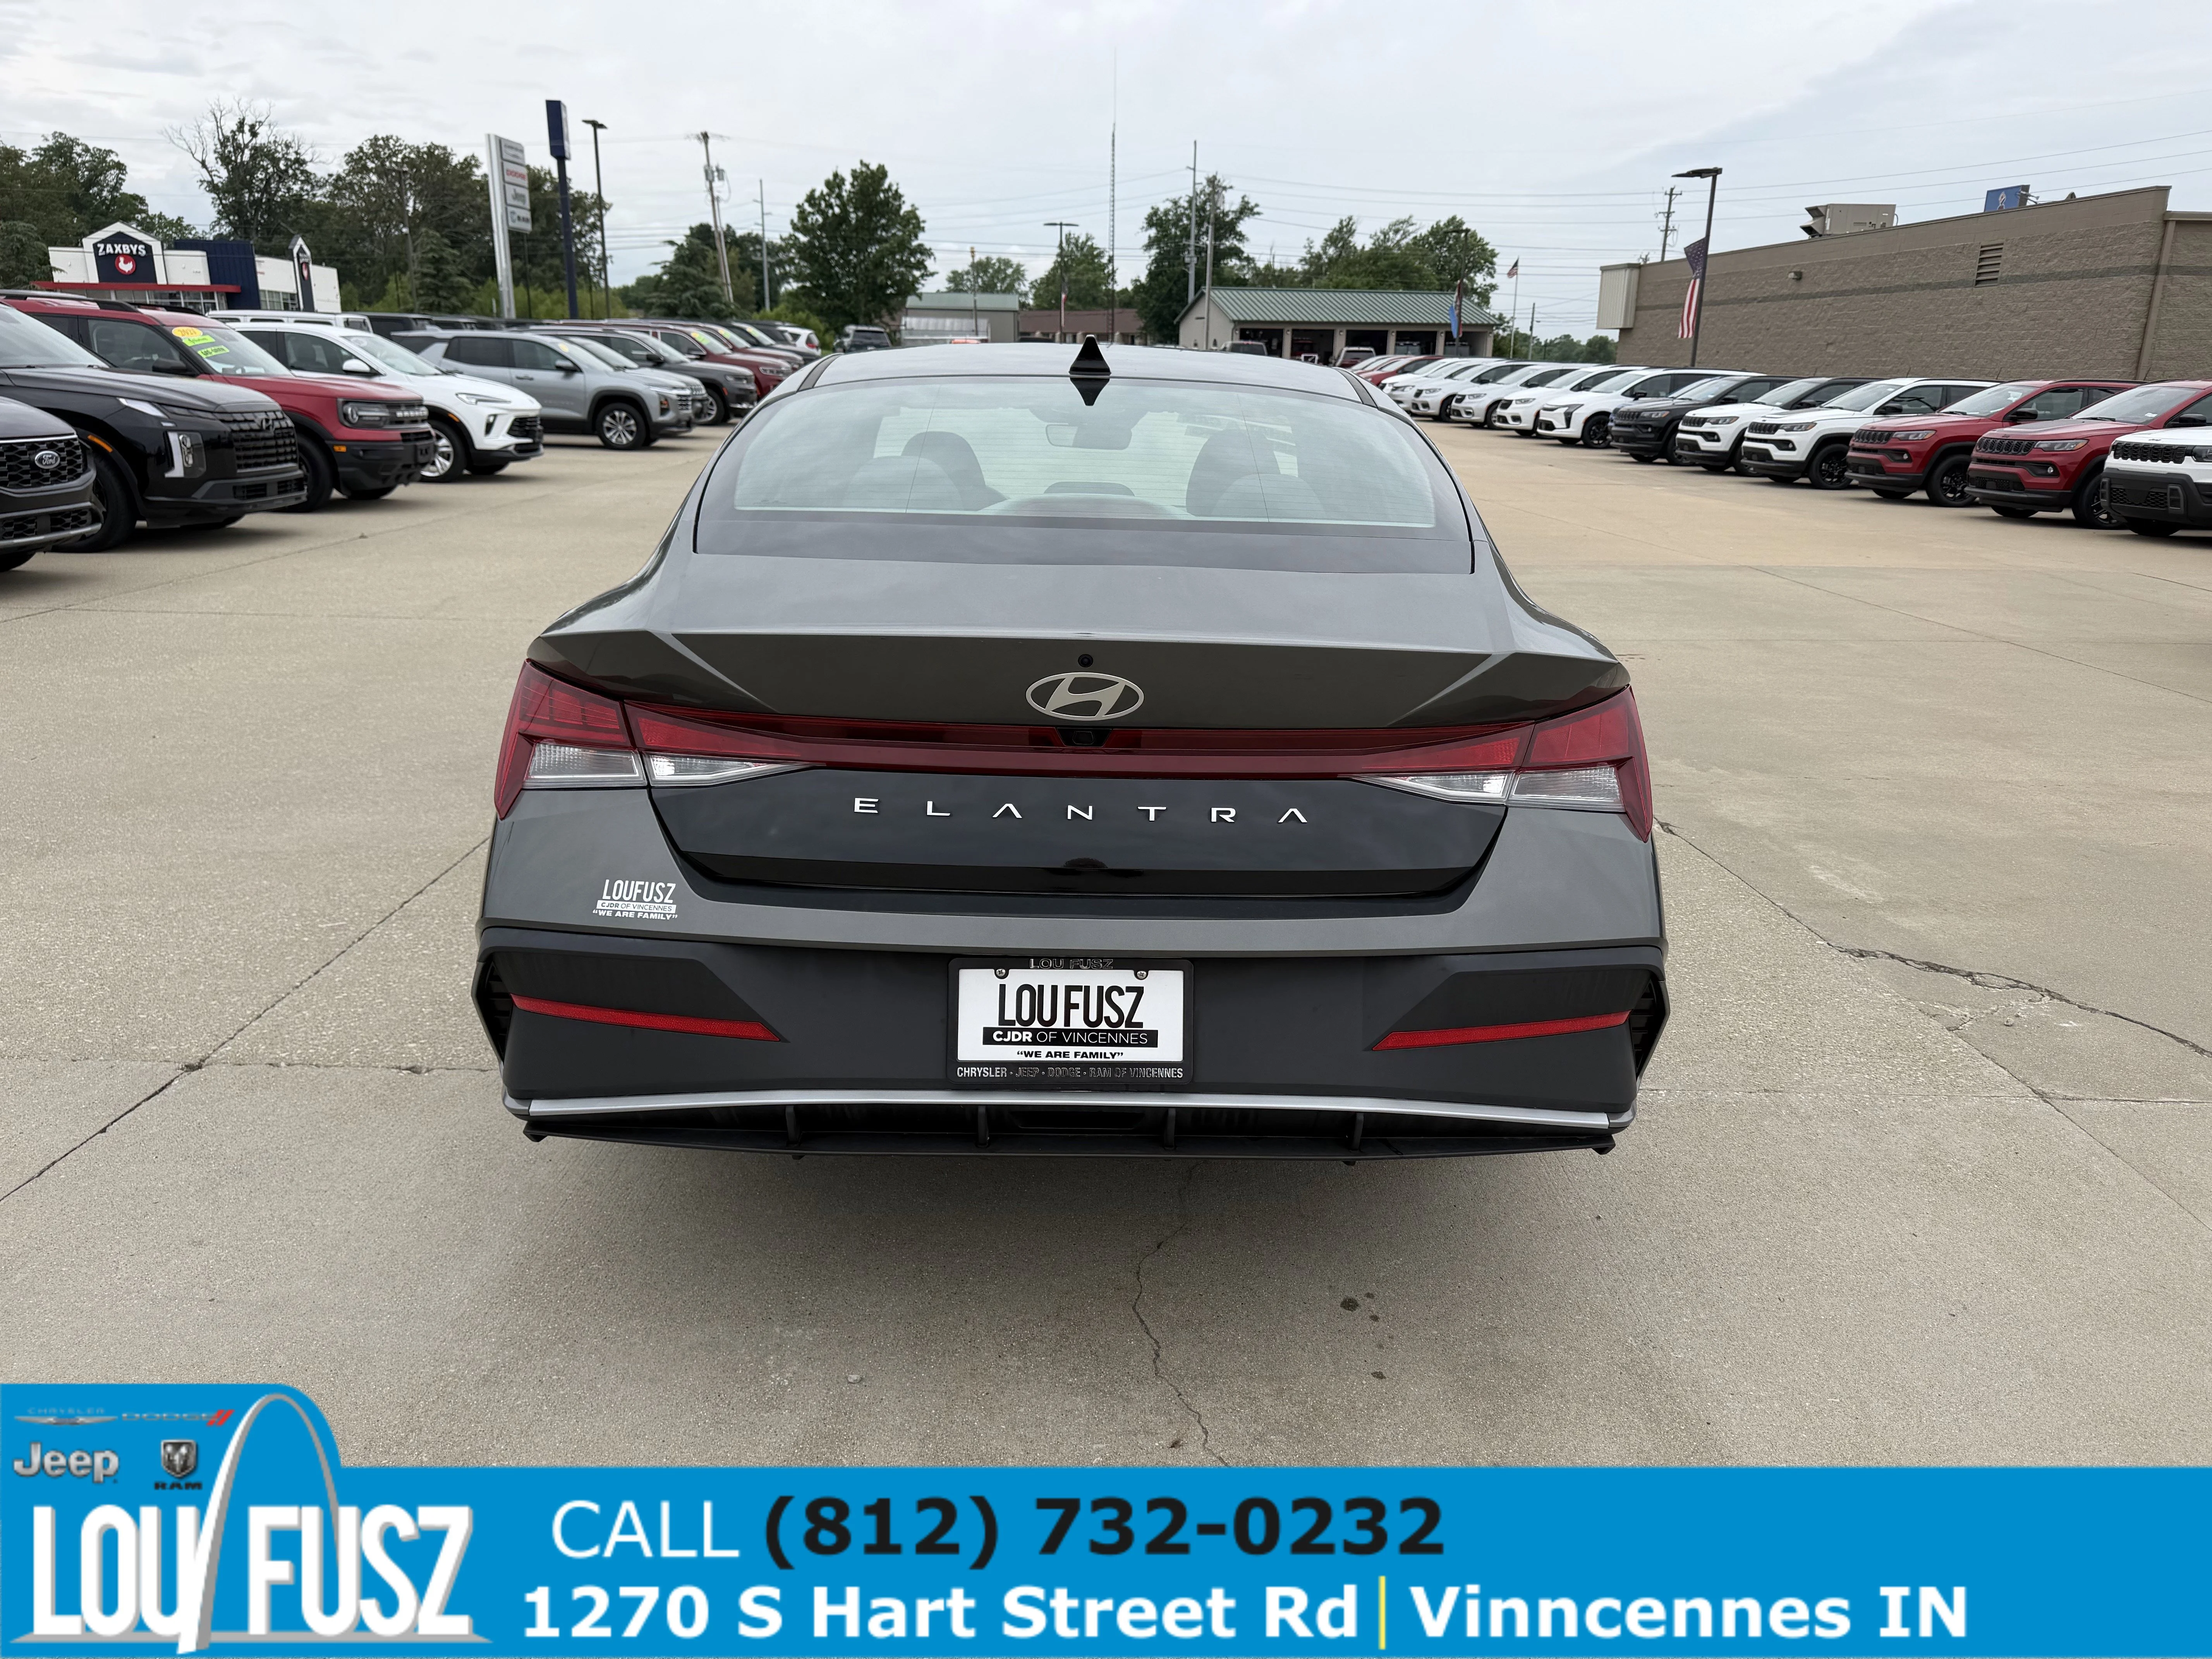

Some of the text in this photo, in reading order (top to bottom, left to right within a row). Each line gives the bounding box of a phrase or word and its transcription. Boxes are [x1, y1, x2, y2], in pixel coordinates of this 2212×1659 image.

[97, 243, 146, 256] ZAXBYS
[42, 454, 55, 465] Ford
[854, 798, 1308, 823] ELANTRA
[1030, 958, 1113, 969] LOU FUSZ
[993, 1031, 1148, 1044] CJDR OF VINCENNES
[957, 1067, 1183, 1078] CHRYSLER JEEP DODGE RAM OF VINCENNES
